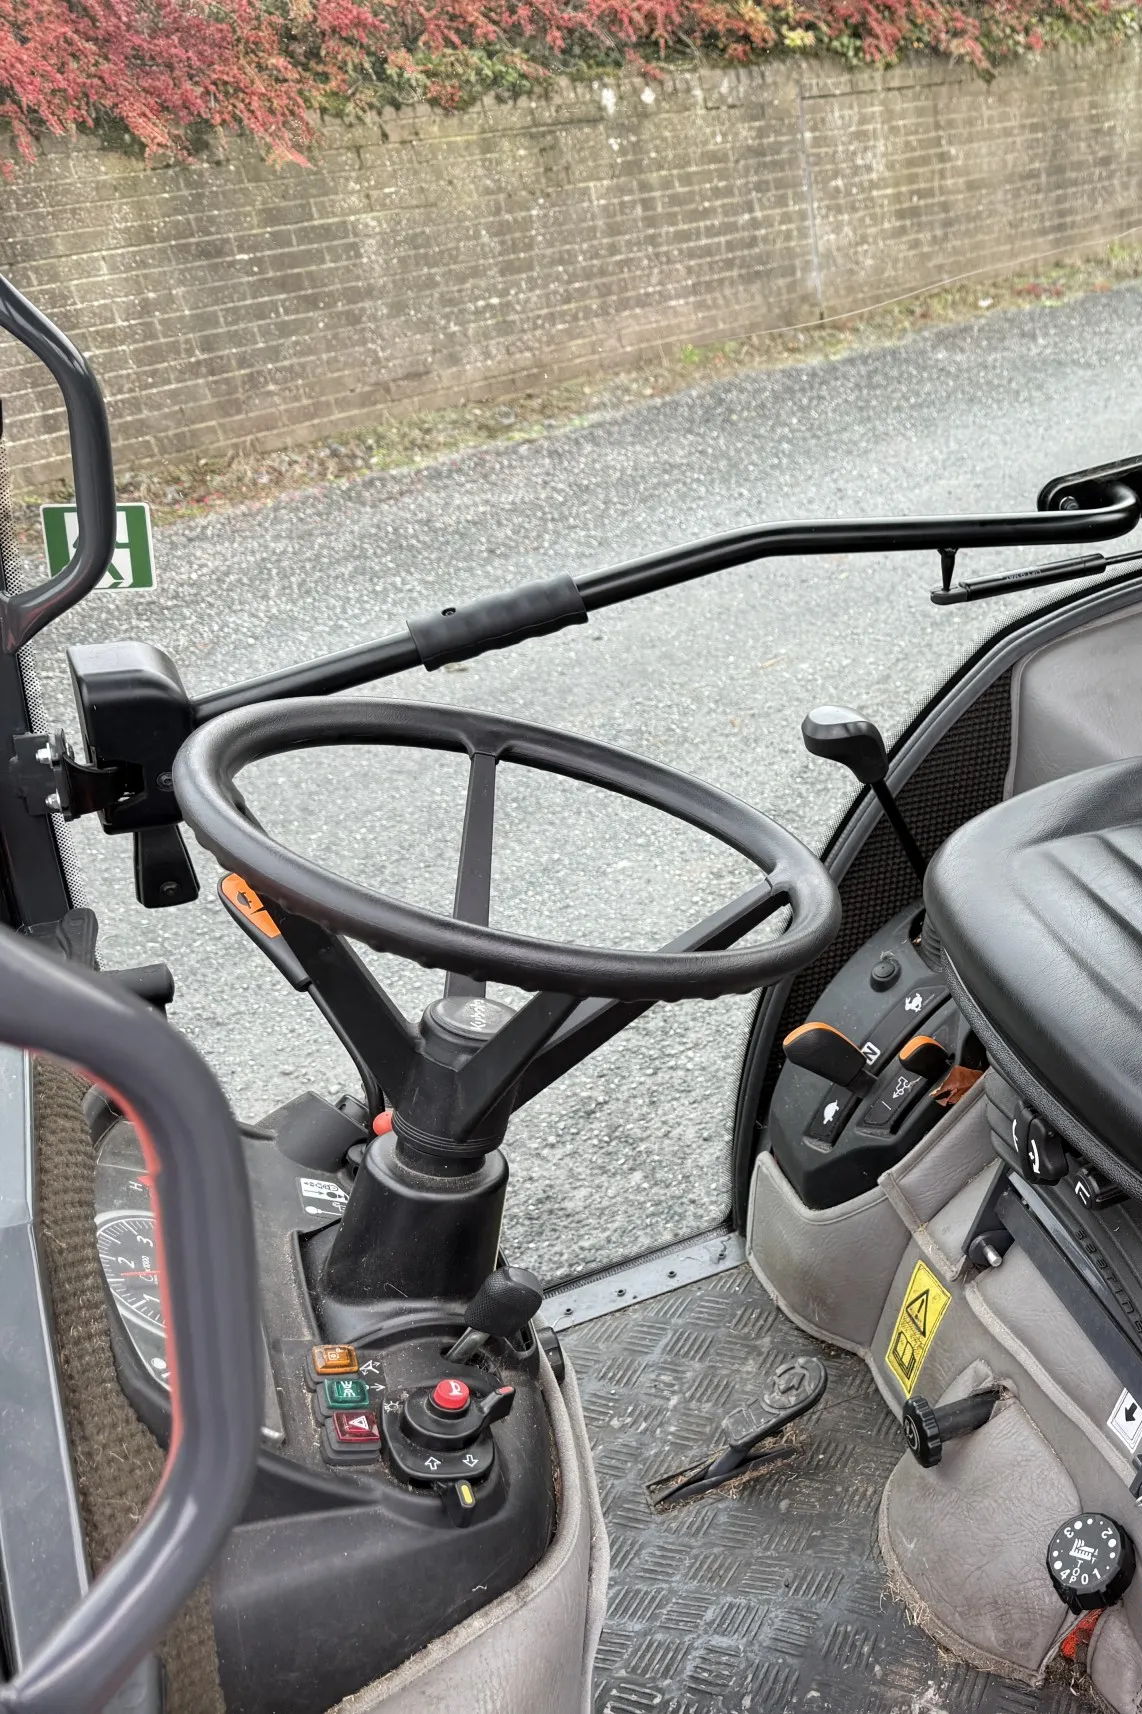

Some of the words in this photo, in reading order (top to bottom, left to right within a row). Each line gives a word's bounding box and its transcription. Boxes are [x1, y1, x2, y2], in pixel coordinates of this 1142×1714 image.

[863, 1045, 878, 1062] N
[136, 1234, 153, 1247] 3
[118, 1256, 135, 1268] 2
[142, 1293, 160, 1303] 1
[1063, 1526, 1074, 1538] 3
[1101, 1527, 1113, 1539] 2
[1060, 1569, 1070, 1580] 4
[1081, 1573, 1088, 1585] 0
[1092, 1568, 1101, 1579] 1
